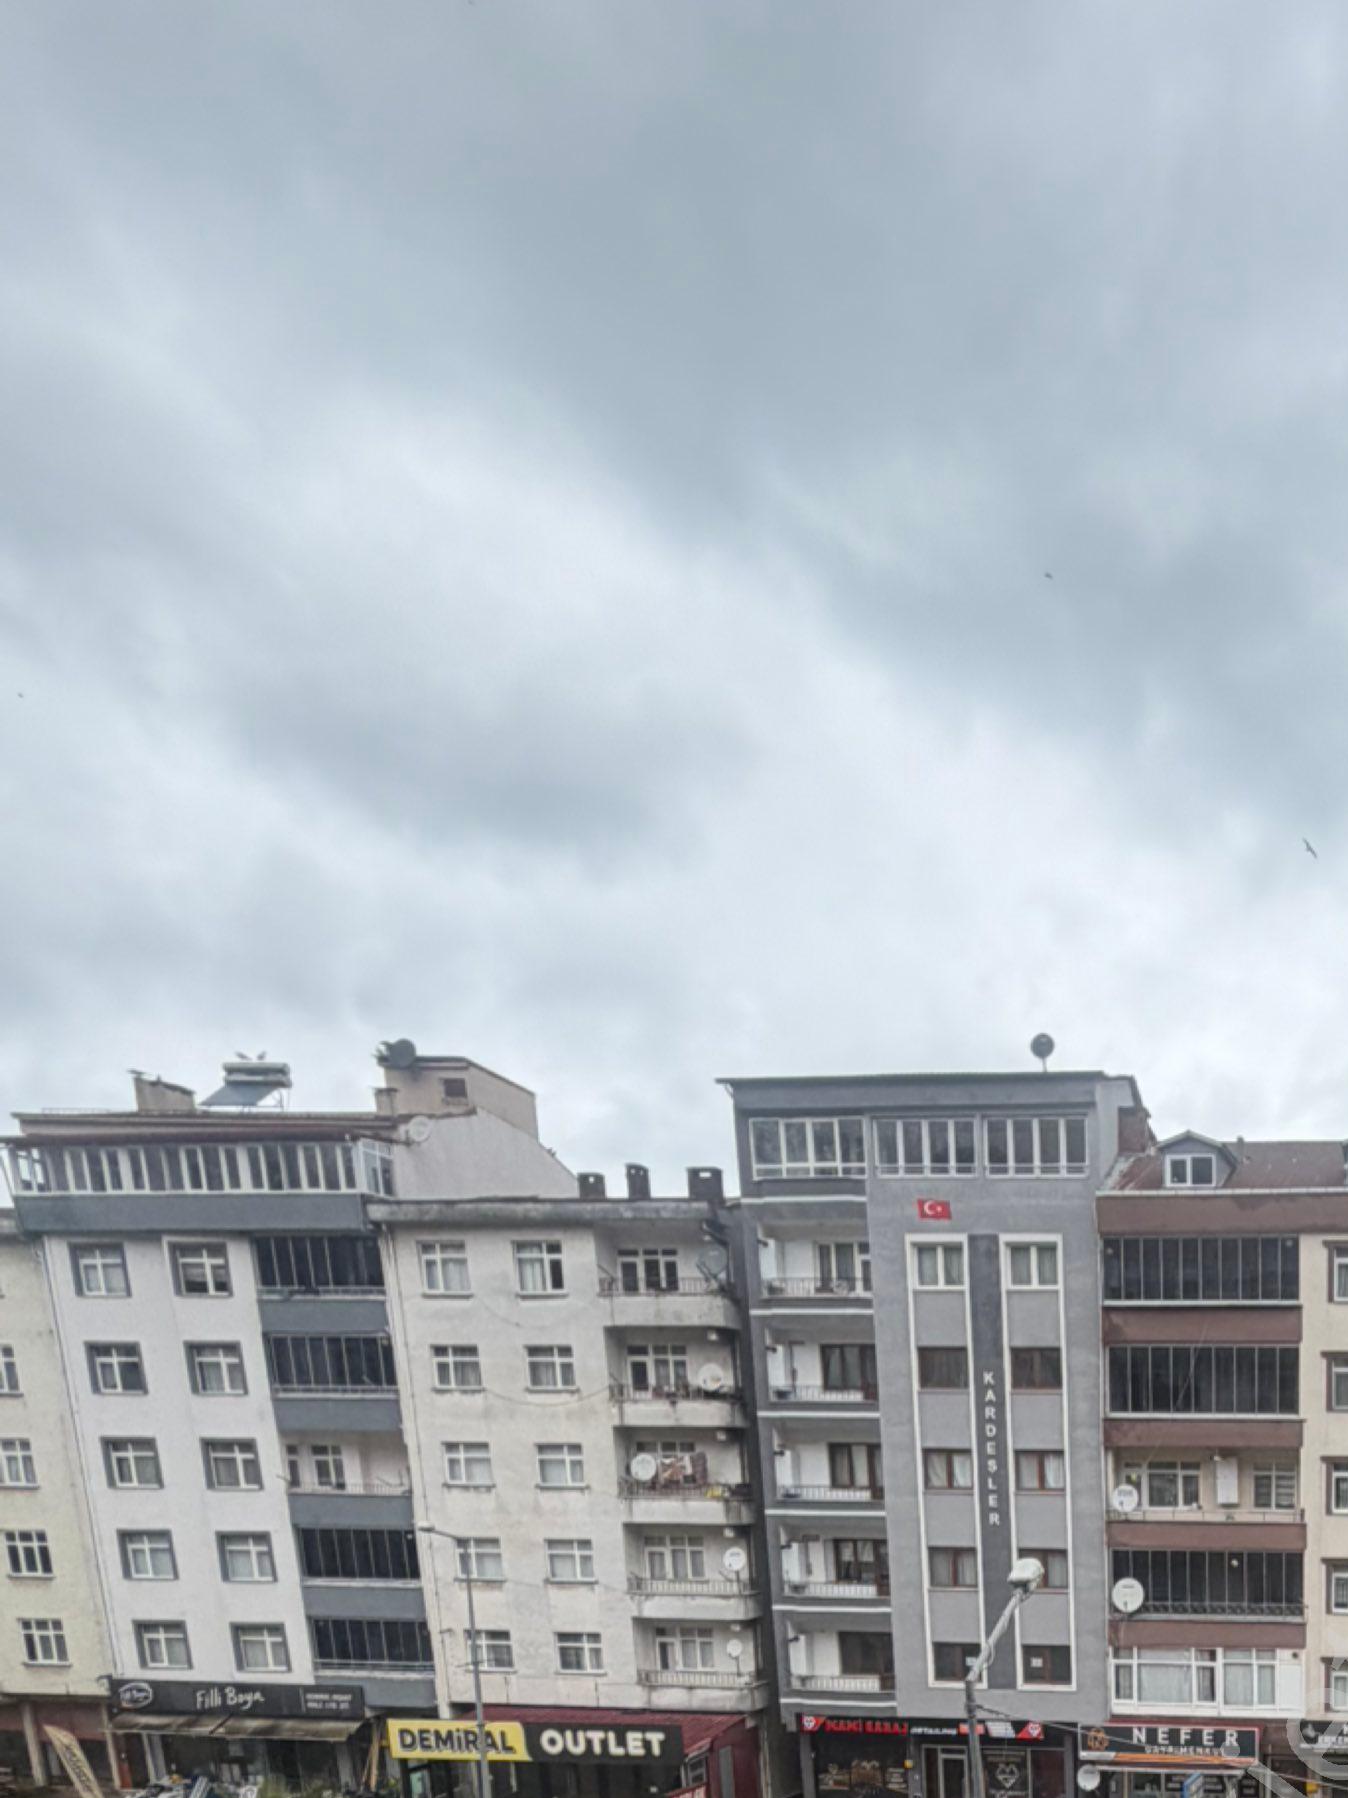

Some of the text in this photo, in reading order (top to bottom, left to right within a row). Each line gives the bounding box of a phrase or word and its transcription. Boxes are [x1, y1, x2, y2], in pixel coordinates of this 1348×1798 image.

[196, 1686, 265, 1710] Filli Boya
[539, 1727, 666, 1757] OUTLET
[1132, 1726, 1239, 1747] NEFER
